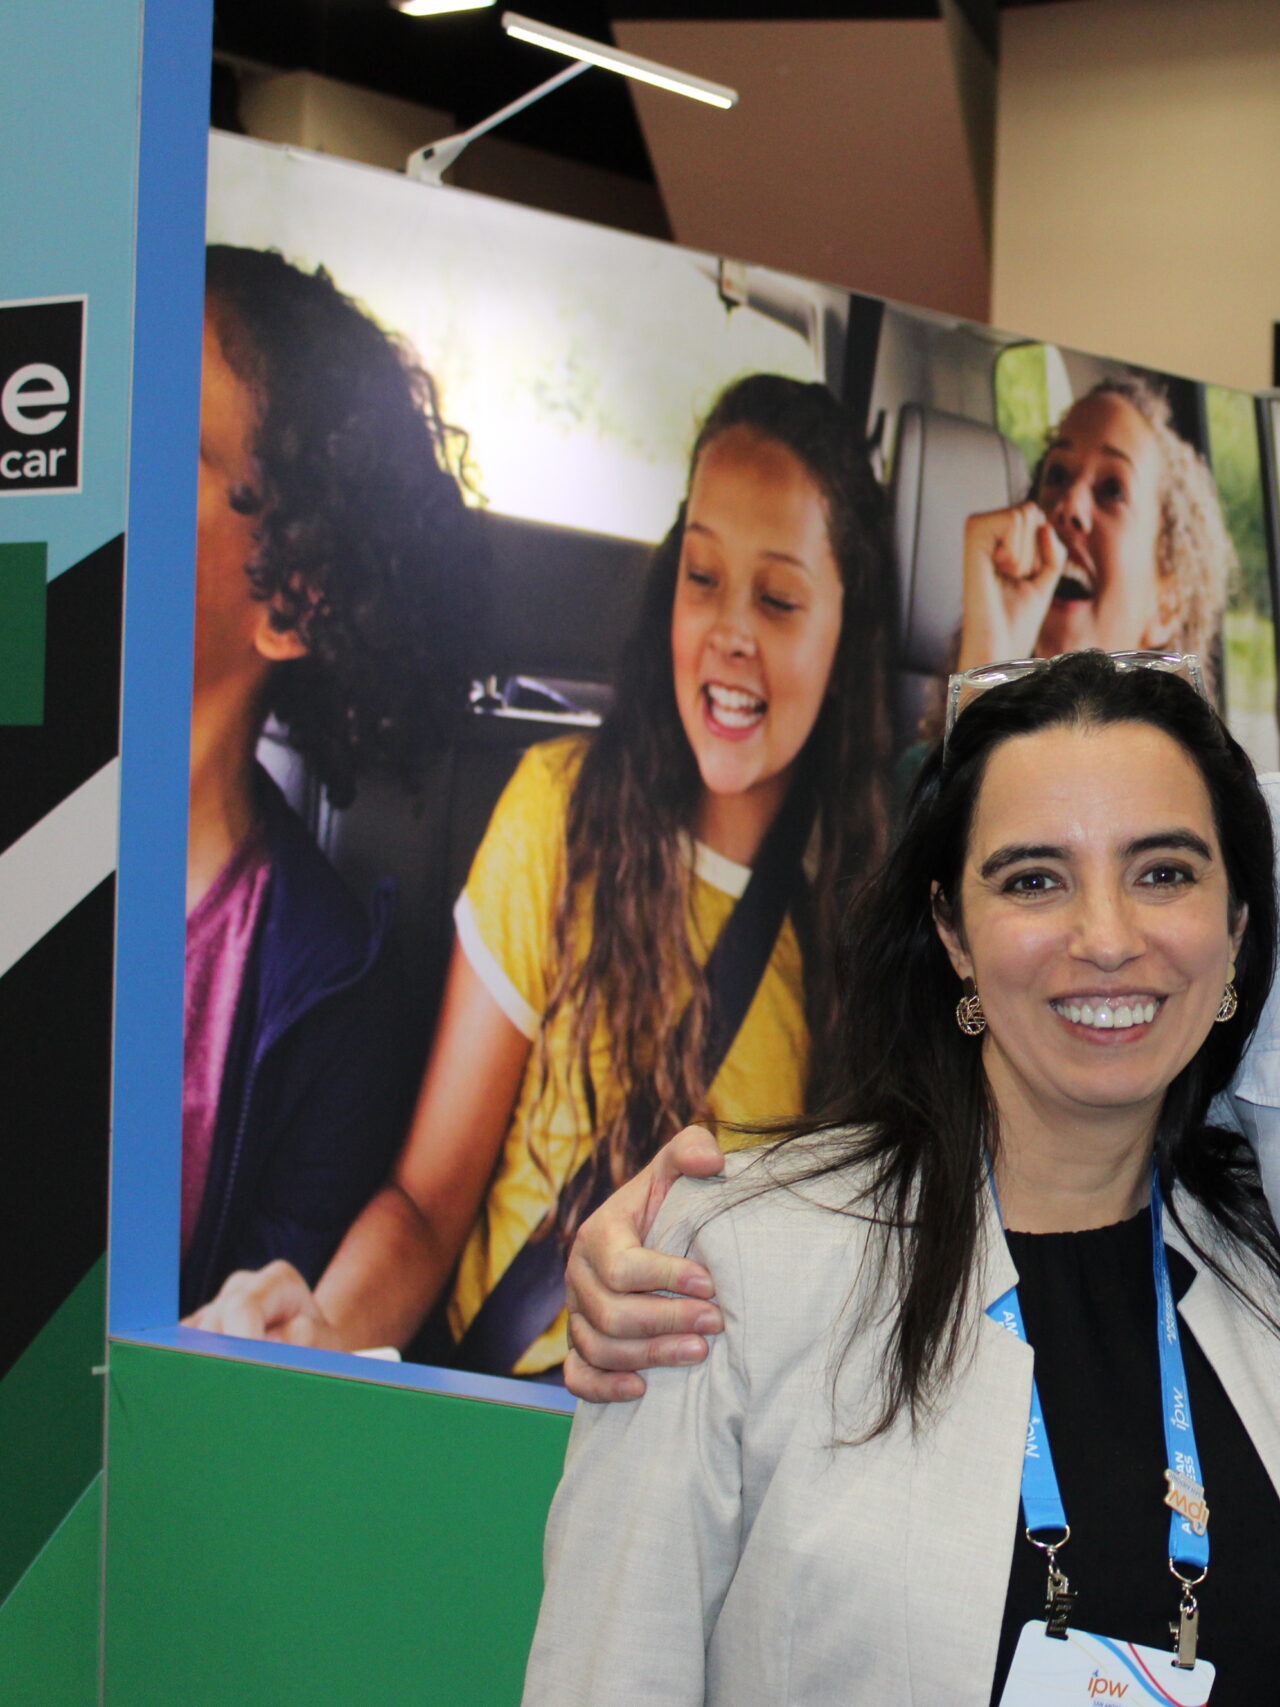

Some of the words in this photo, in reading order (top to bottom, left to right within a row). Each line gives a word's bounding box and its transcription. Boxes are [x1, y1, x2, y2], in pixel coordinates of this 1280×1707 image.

[0, 447, 67, 479] car
[1171, 1387, 1190, 1431] ipw
[1088, 1669, 1129, 1698] ipw
